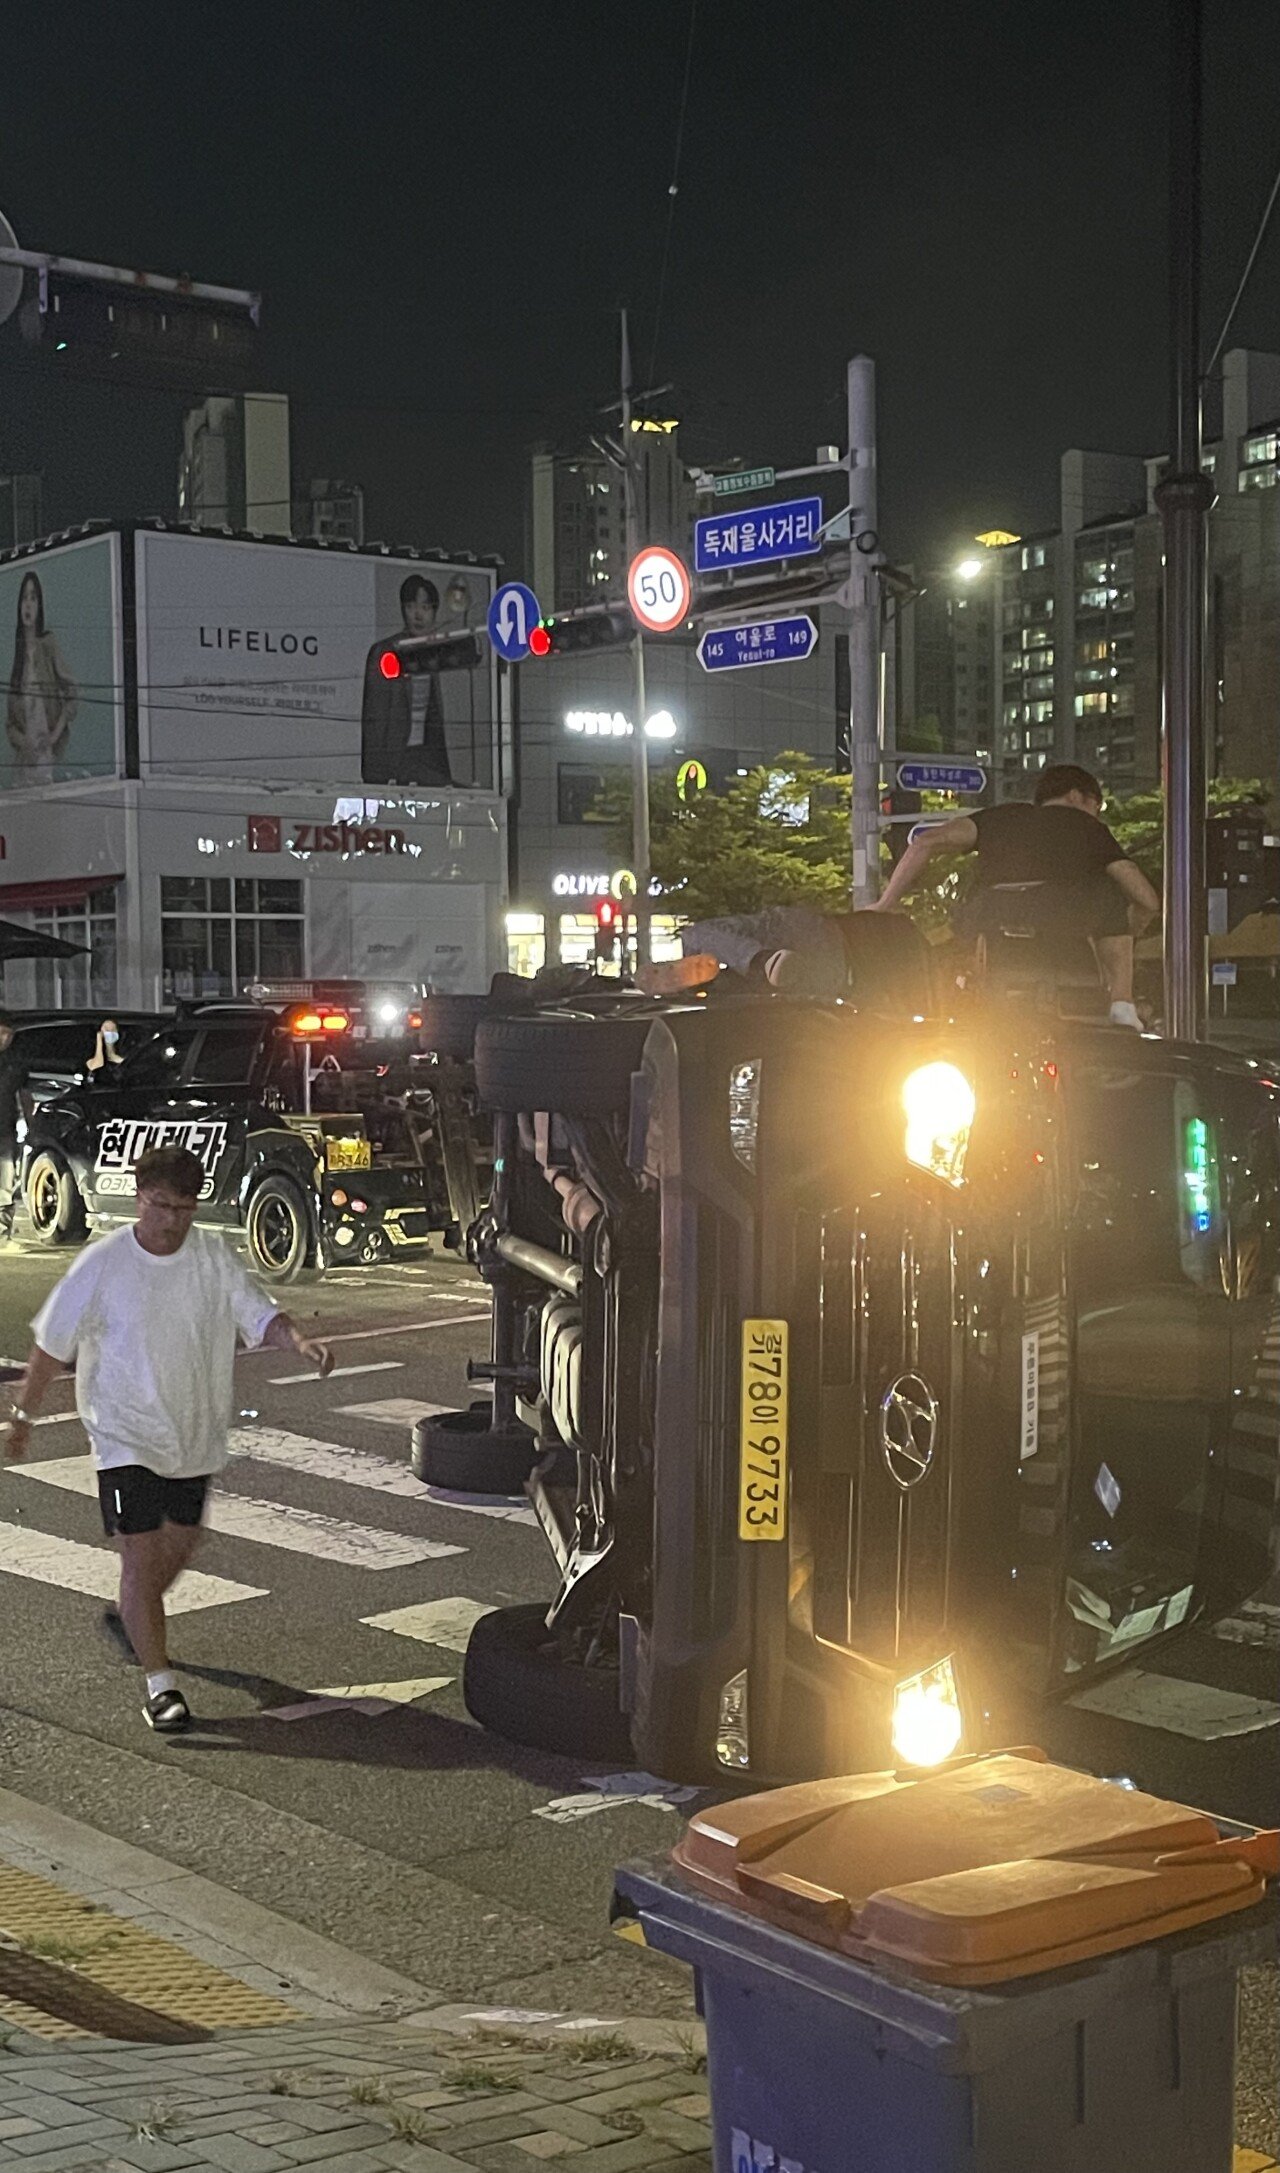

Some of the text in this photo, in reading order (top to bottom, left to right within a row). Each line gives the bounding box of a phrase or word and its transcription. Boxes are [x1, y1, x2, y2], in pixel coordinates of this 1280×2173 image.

[703, 510, 813, 557] 독재울사거리
[641, 571, 676, 606] 50
[200, 626, 319, 656] LIFELOG
[706, 625, 808, 658] 145 여울로 149
[294, 824, 406, 856] zishen
[552, 873, 610, 895] OLIVE
[745, 1435, 781, 1525] 9733
